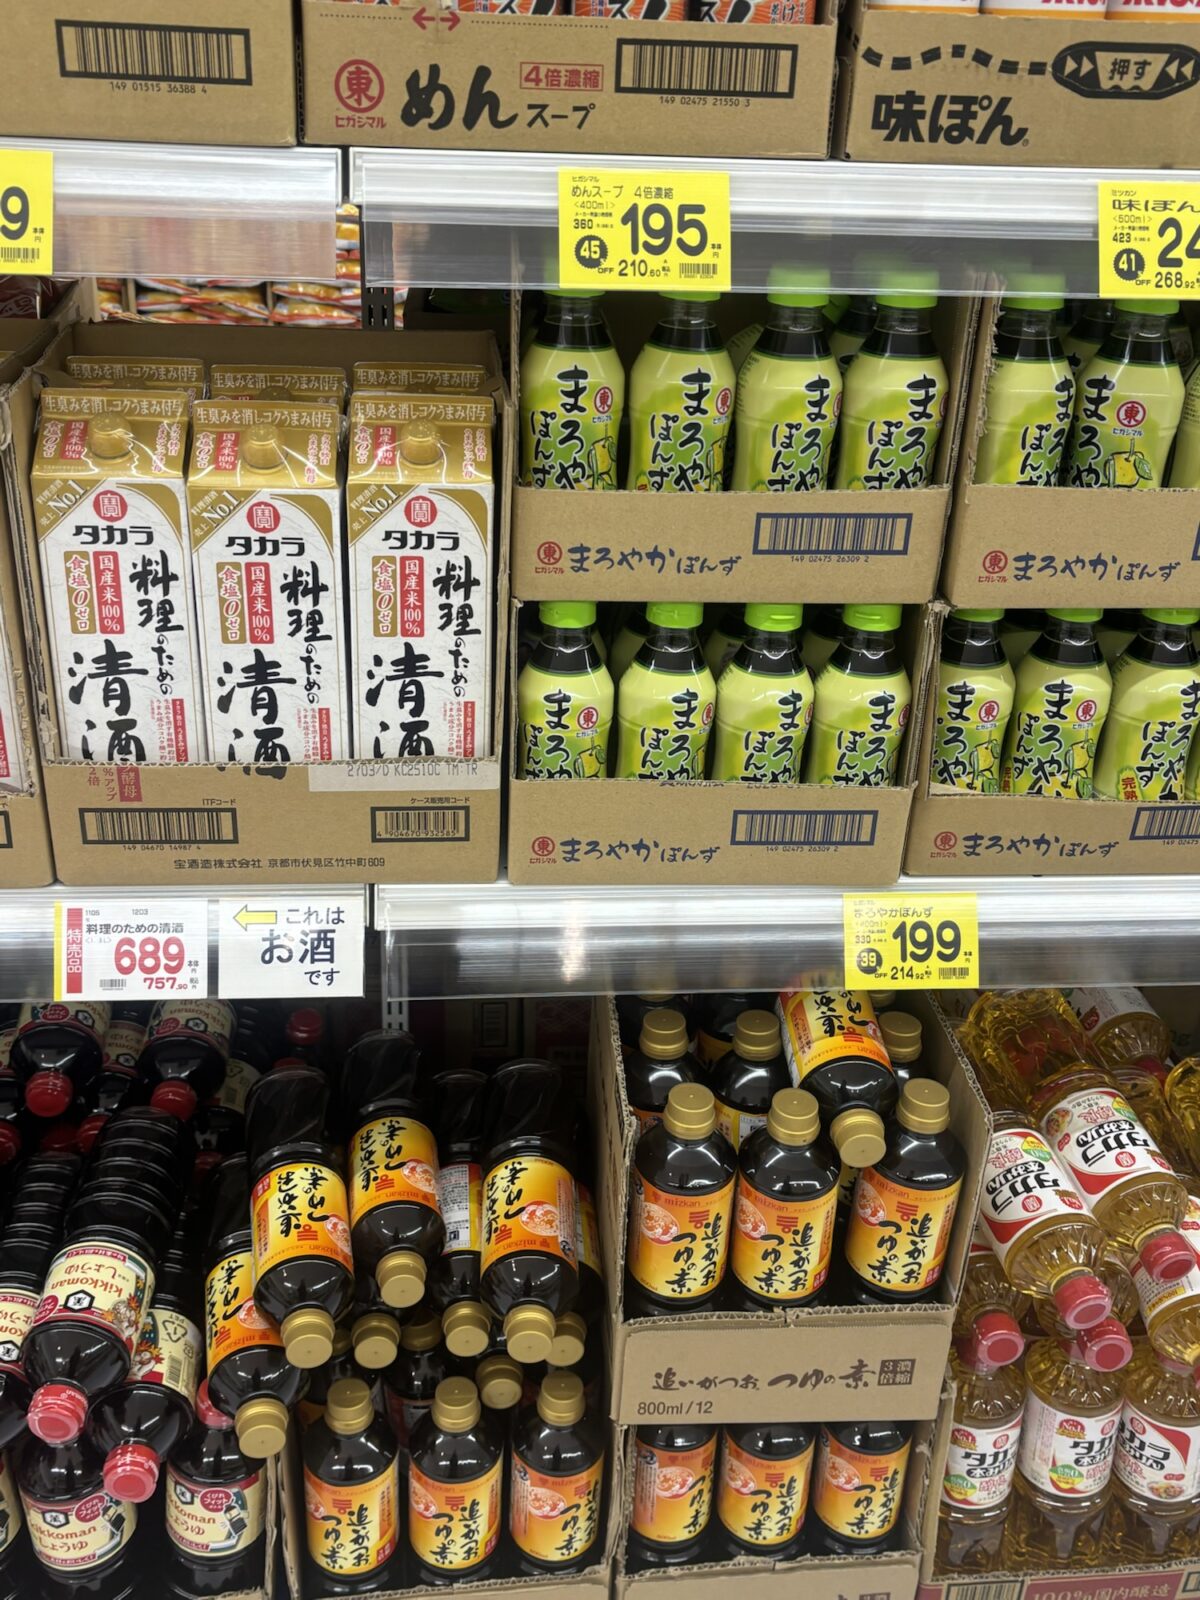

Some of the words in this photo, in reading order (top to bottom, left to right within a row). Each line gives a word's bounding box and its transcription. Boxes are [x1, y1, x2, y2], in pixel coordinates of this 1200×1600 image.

[523, 66, 602, 89] 4倍濃縮
[1108, 58, 1152, 81] 押す
[109, 81, 128, 91] 149
[132, 82, 162, 93] 01515
[167, 83, 198, 95] 36388
[201, 85, 207, 95] 4
[344, 69, 376, 105] 東
[400, 63, 517, 132] めん
[659, 96, 677, 105] 149
[681, 97, 708, 106] 02475
[713, 98, 741, 107] 21550
[745, 98, 752, 107] 3
[335, 114, 388, 129] ヒガシマル
[526, 103, 596, 130] スープ
[871, 90, 1029, 146] 味ぽん
[572, 185, 624, 198] めんスープ
[634, 186, 674, 200] 4倍濃縮
[573, 219, 593, 229] 360
[621, 203, 708, 256] 195
[1112, 233, 1131, 243] 423
[580, 240, 600, 260] 45
[1119, 253, 1135, 271] 41
[618, 260, 661, 278] 210.60
[1155, 272, 1195, 289] 268.92
[1124, 404, 1139, 424] 東
[1112, 428, 1143, 437] ヒガシマル
[530, 410, 557, 489] ぽんず
[648, 414, 679, 491] ぽんず
[48, 480, 89, 516] No.1
[201, 491, 240, 528] No.1
[361, 484, 400, 521] No.1
[73, 525, 154, 545] タカラ
[225, 536, 305, 557] タカラ
[382, 531, 460, 551] タカラ
[544, 545, 558, 561] 東
[568, 543, 742, 576] まろやかぽんず
[989, 554, 1002, 570] 東
[1013, 552, 1181, 582] まろやかぽんず
[535, 566, 565, 575] ヒガシマル
[978, 575, 1008, 583] ヒガシマル
[99, 554, 120, 632] 国産米100%
[251, 566, 270, 642] 国産米100%
[404, 559, 421, 635] 国産米100%
[129, 550, 184, 695] 料理のための
[280, 561, 332, 704] 料理のための
[433, 555, 481, 698] 料理のための
[68, 638, 149, 762] 清酒
[217, 648, 297, 774] 清酒
[365, 641, 444, 759] 清酒
[983, 703, 995, 720] 東
[1081, 703, 1093, 720] 東
[1014, 712, 1040, 779] ぽんず
[1136, 722, 1176, 787] ぽんず
[538, 839, 551, 855] 東
[560, 838, 720, 864] まろやかぽんず
[940, 834, 953, 849] 東
[962, 833, 1119, 857] まろやかぽんず
[174, 858, 263, 870] 宝酒造株式会社
[268, 857, 386, 869] 京都市伏見区竹中町609
[86, 923, 184, 934] 料理のための清酒
[286, 906, 345, 926] これは
[66, 929, 82, 974] 特売品
[114, 936, 186, 975] 689
[261, 928, 336, 964] お酒
[892, 920, 961, 963] 199
[860, 952, 877, 967] 39
[304, 970, 340, 986] です
[378, 1120, 408, 1171] つゆの素
[1079, 1120, 1132, 1146] 本みりん
[1081, 1132, 1150, 1167] タカラ
[500, 1161, 529, 1220] つゆの素
[987, 1161, 1042, 1193] 本みりん
[300, 1167, 329, 1222] つゆの素
[664, 1197, 701, 1208] mizkan
[754, 1195, 788, 1212] mizkan
[991, 1172, 1060, 1215] タカラ
[665, 1232, 698, 1295] つゆの素
[754, 1233, 785, 1295] つゆの素
[868, 1220, 902, 1284] つゆの素
[64, 1262, 118, 1279] しょうゆ
[51, 1276, 124, 1297] kikkoman
[217, 1259, 244, 1321] つゆの素
[652, 1367, 759, 1391] 追いがつお
[767, 1359, 876, 1389] つゆの素
[637, 1401, 713, 1416] 800ml/12
[744, 1488, 773, 1540] つゆの素
[846, 1484, 876, 1534] つゆの素
[321, 1515, 347, 1569] つゆの素
[431, 1512, 458, 1566] つゆの素
[554, 1503, 582, 1556] つゆの素
[39, 1540, 88, 1552] しょうゆ
